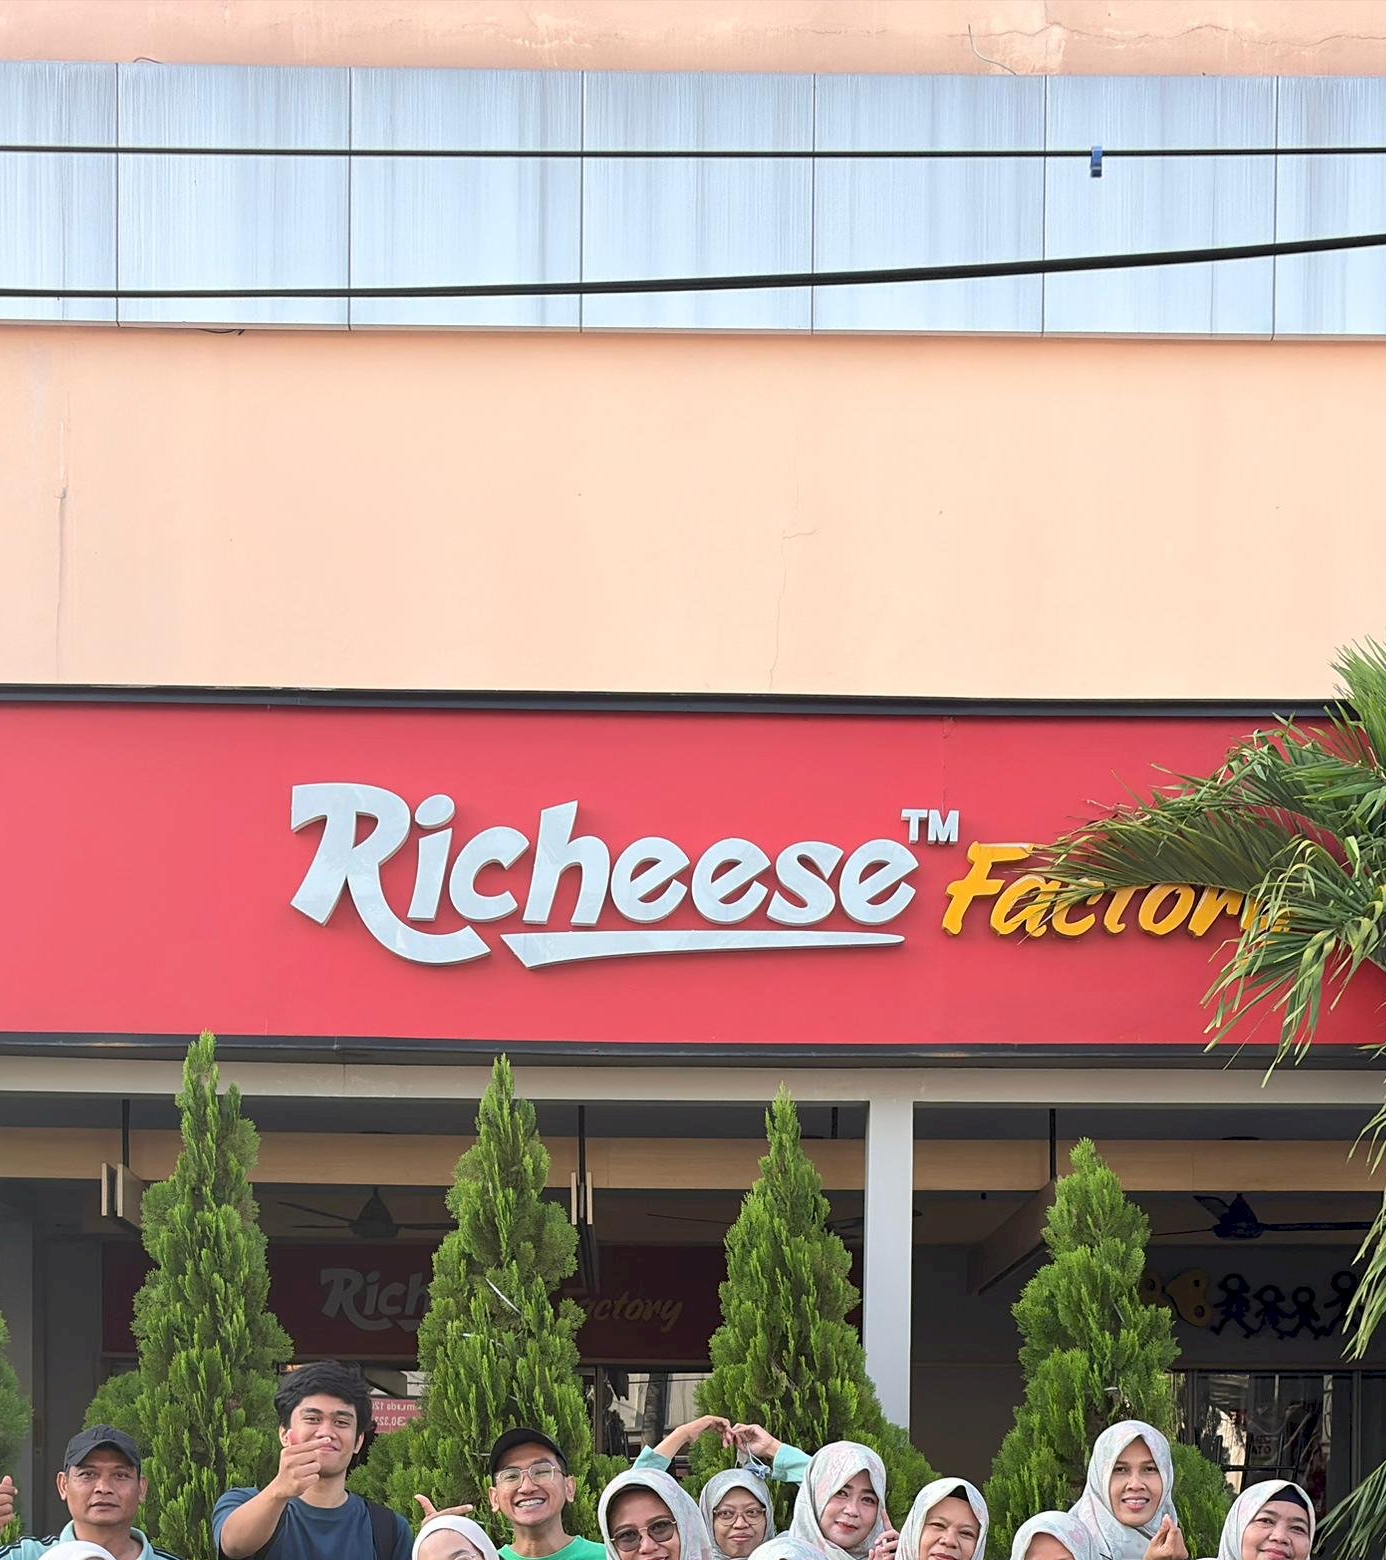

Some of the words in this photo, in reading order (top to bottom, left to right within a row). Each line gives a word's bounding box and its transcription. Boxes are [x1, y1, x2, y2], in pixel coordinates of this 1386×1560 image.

[290, 782, 919, 968] Richeese
[901, 809, 959, 843] TM
[942, 841, 1293, 940] Factor
